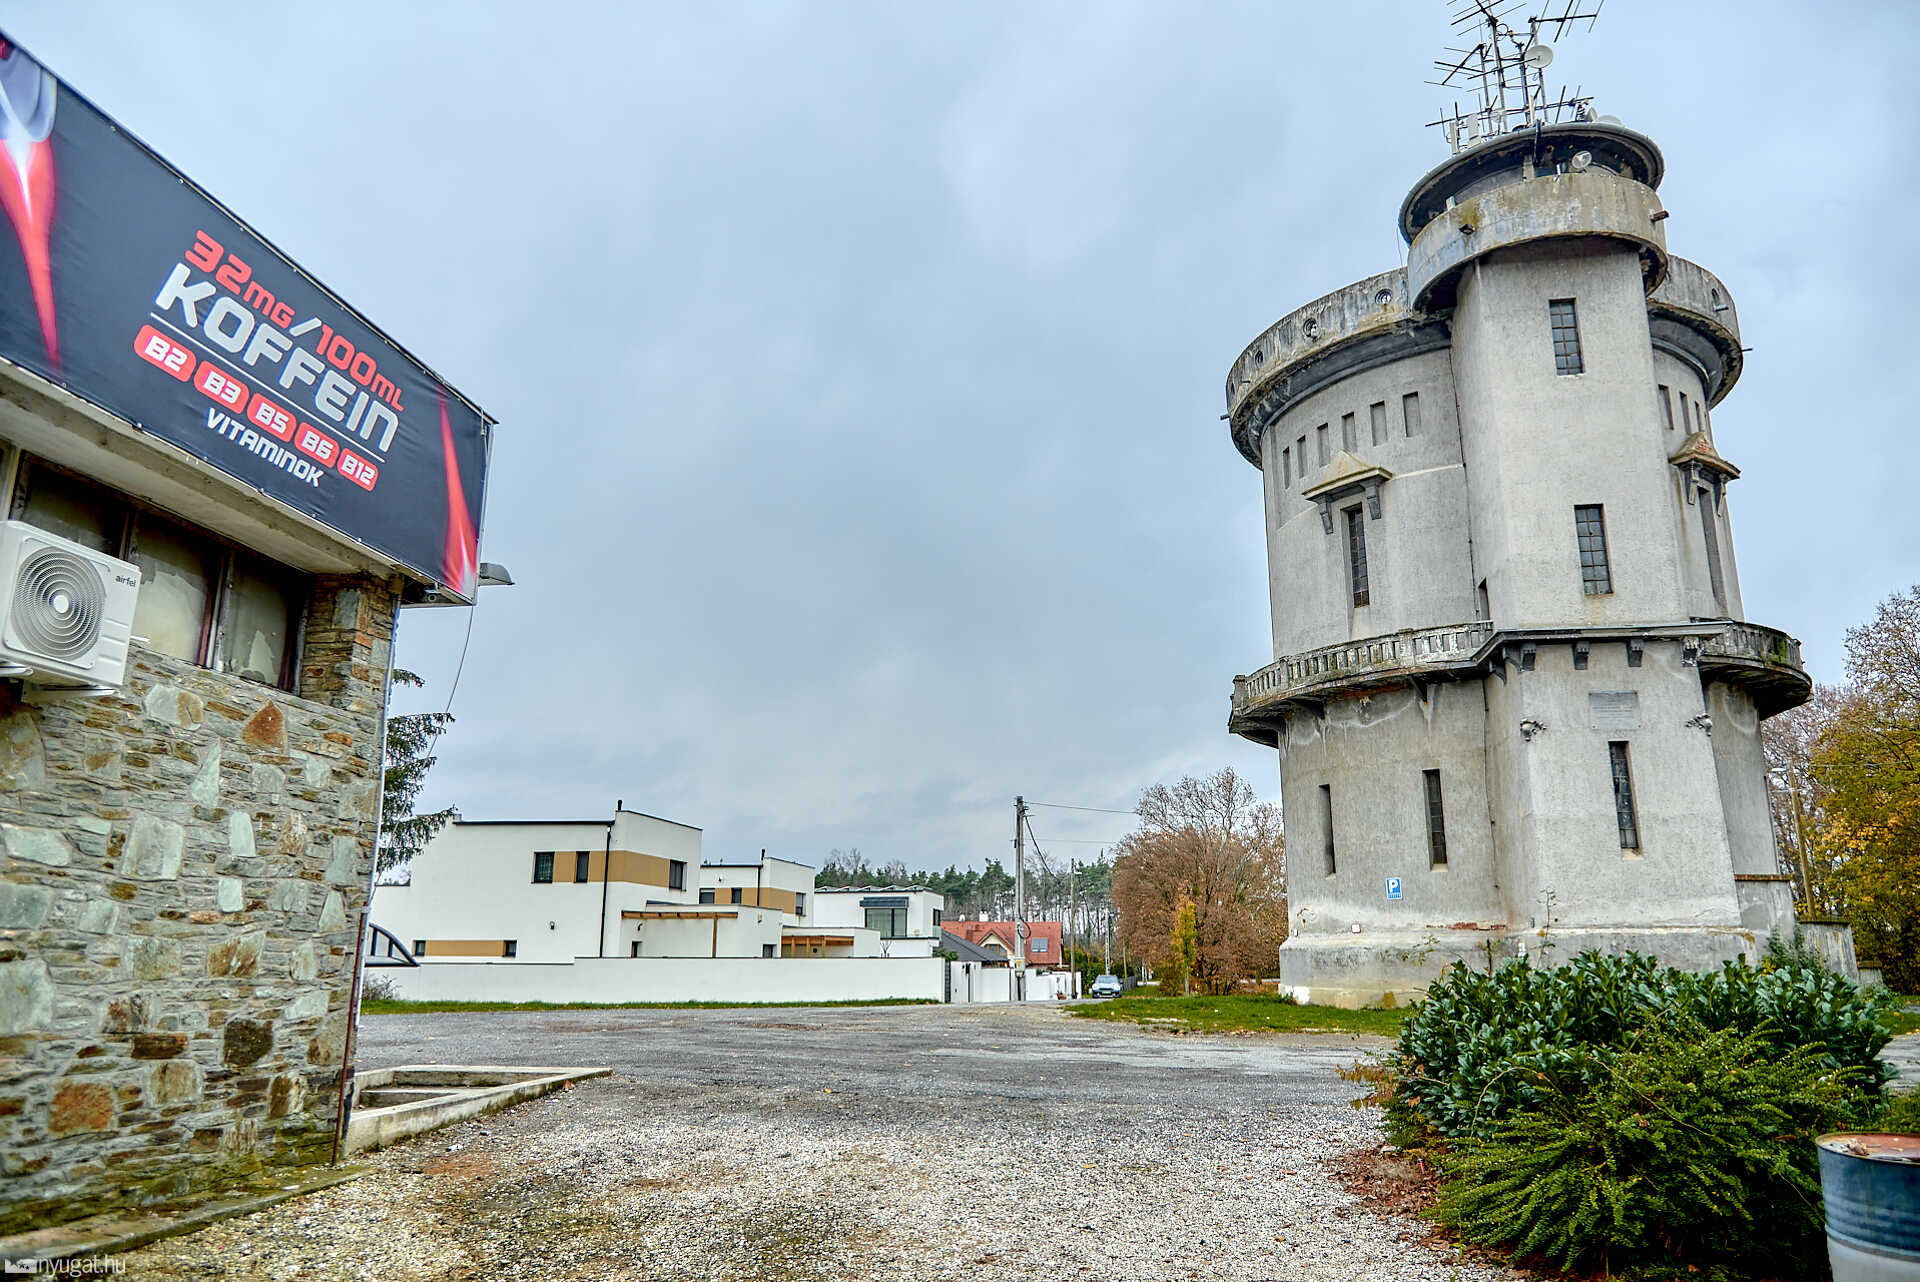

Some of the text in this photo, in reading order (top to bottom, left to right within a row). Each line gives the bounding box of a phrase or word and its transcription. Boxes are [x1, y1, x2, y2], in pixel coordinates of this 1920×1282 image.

[155, 262, 400, 452] KOFFEIN
[144, 335, 376, 486] B2 B3 B5 B6 B12
[205, 407, 325, 487] VITAMINOK
[115, 575, 136, 588] airfel
[1389, 880, 1399, 893] P
